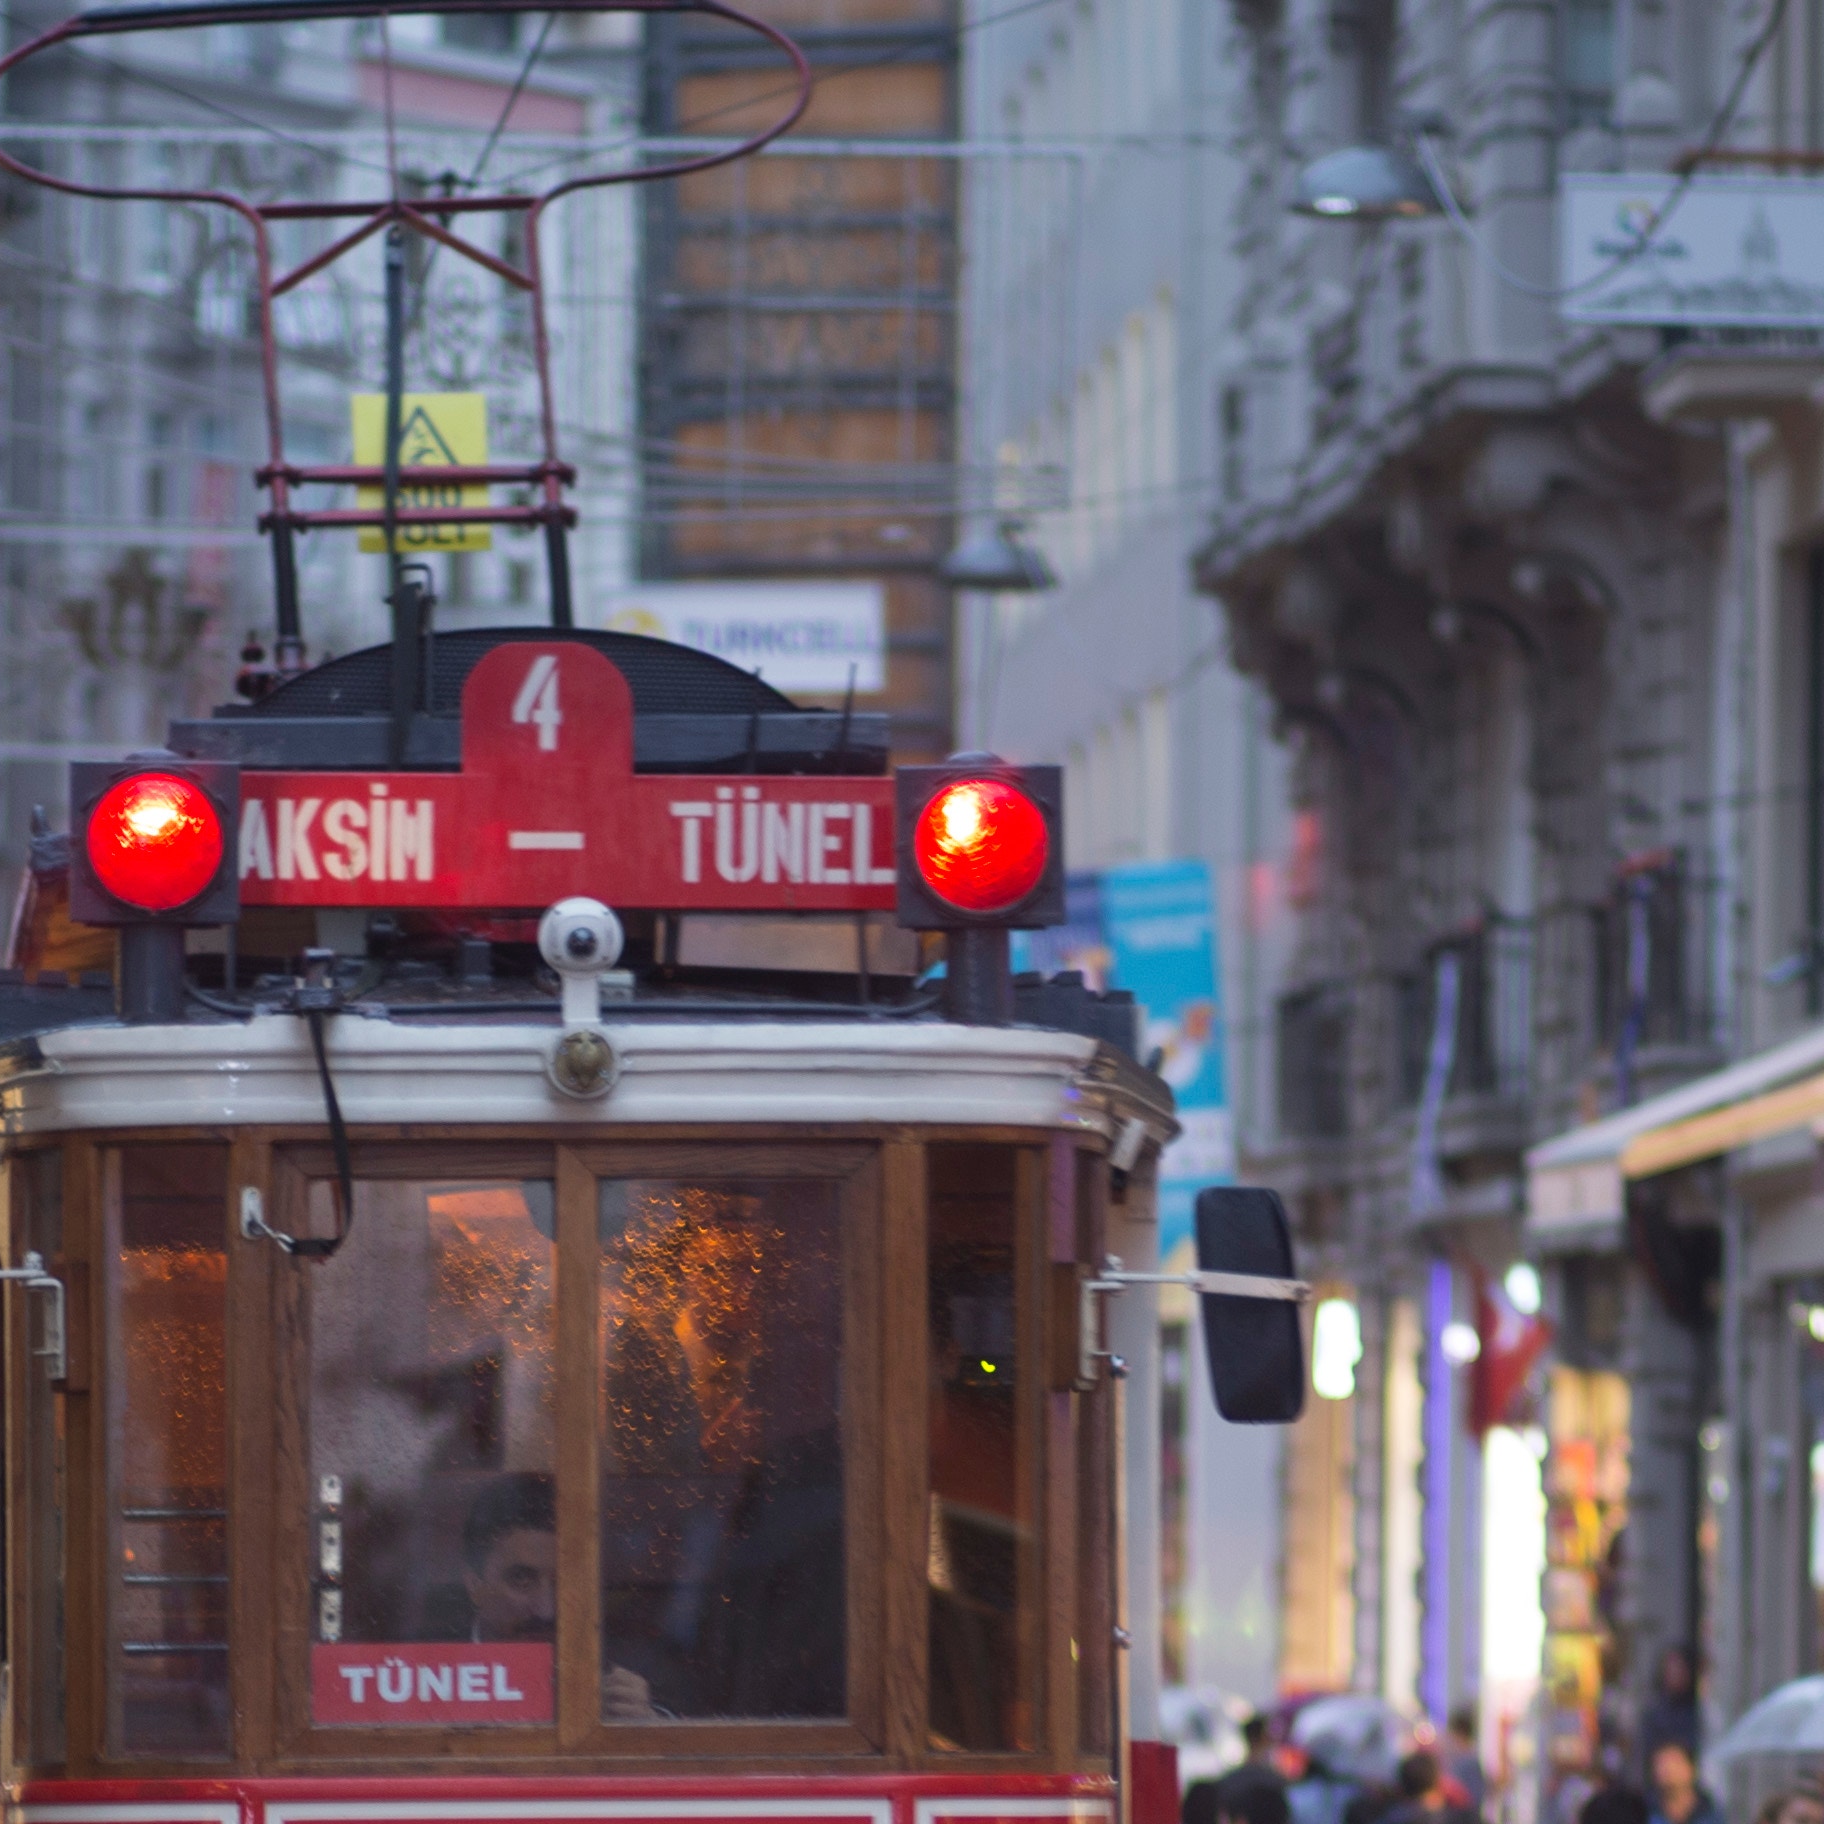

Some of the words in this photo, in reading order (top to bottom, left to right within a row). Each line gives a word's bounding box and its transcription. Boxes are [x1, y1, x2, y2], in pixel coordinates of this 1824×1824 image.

[512, 655, 563, 752] 4
[237, 783, 434, 881] AKSİM
[670, 785, 897, 885] TÜNEL
[339, 1656, 524, 1704] TÜNEL
